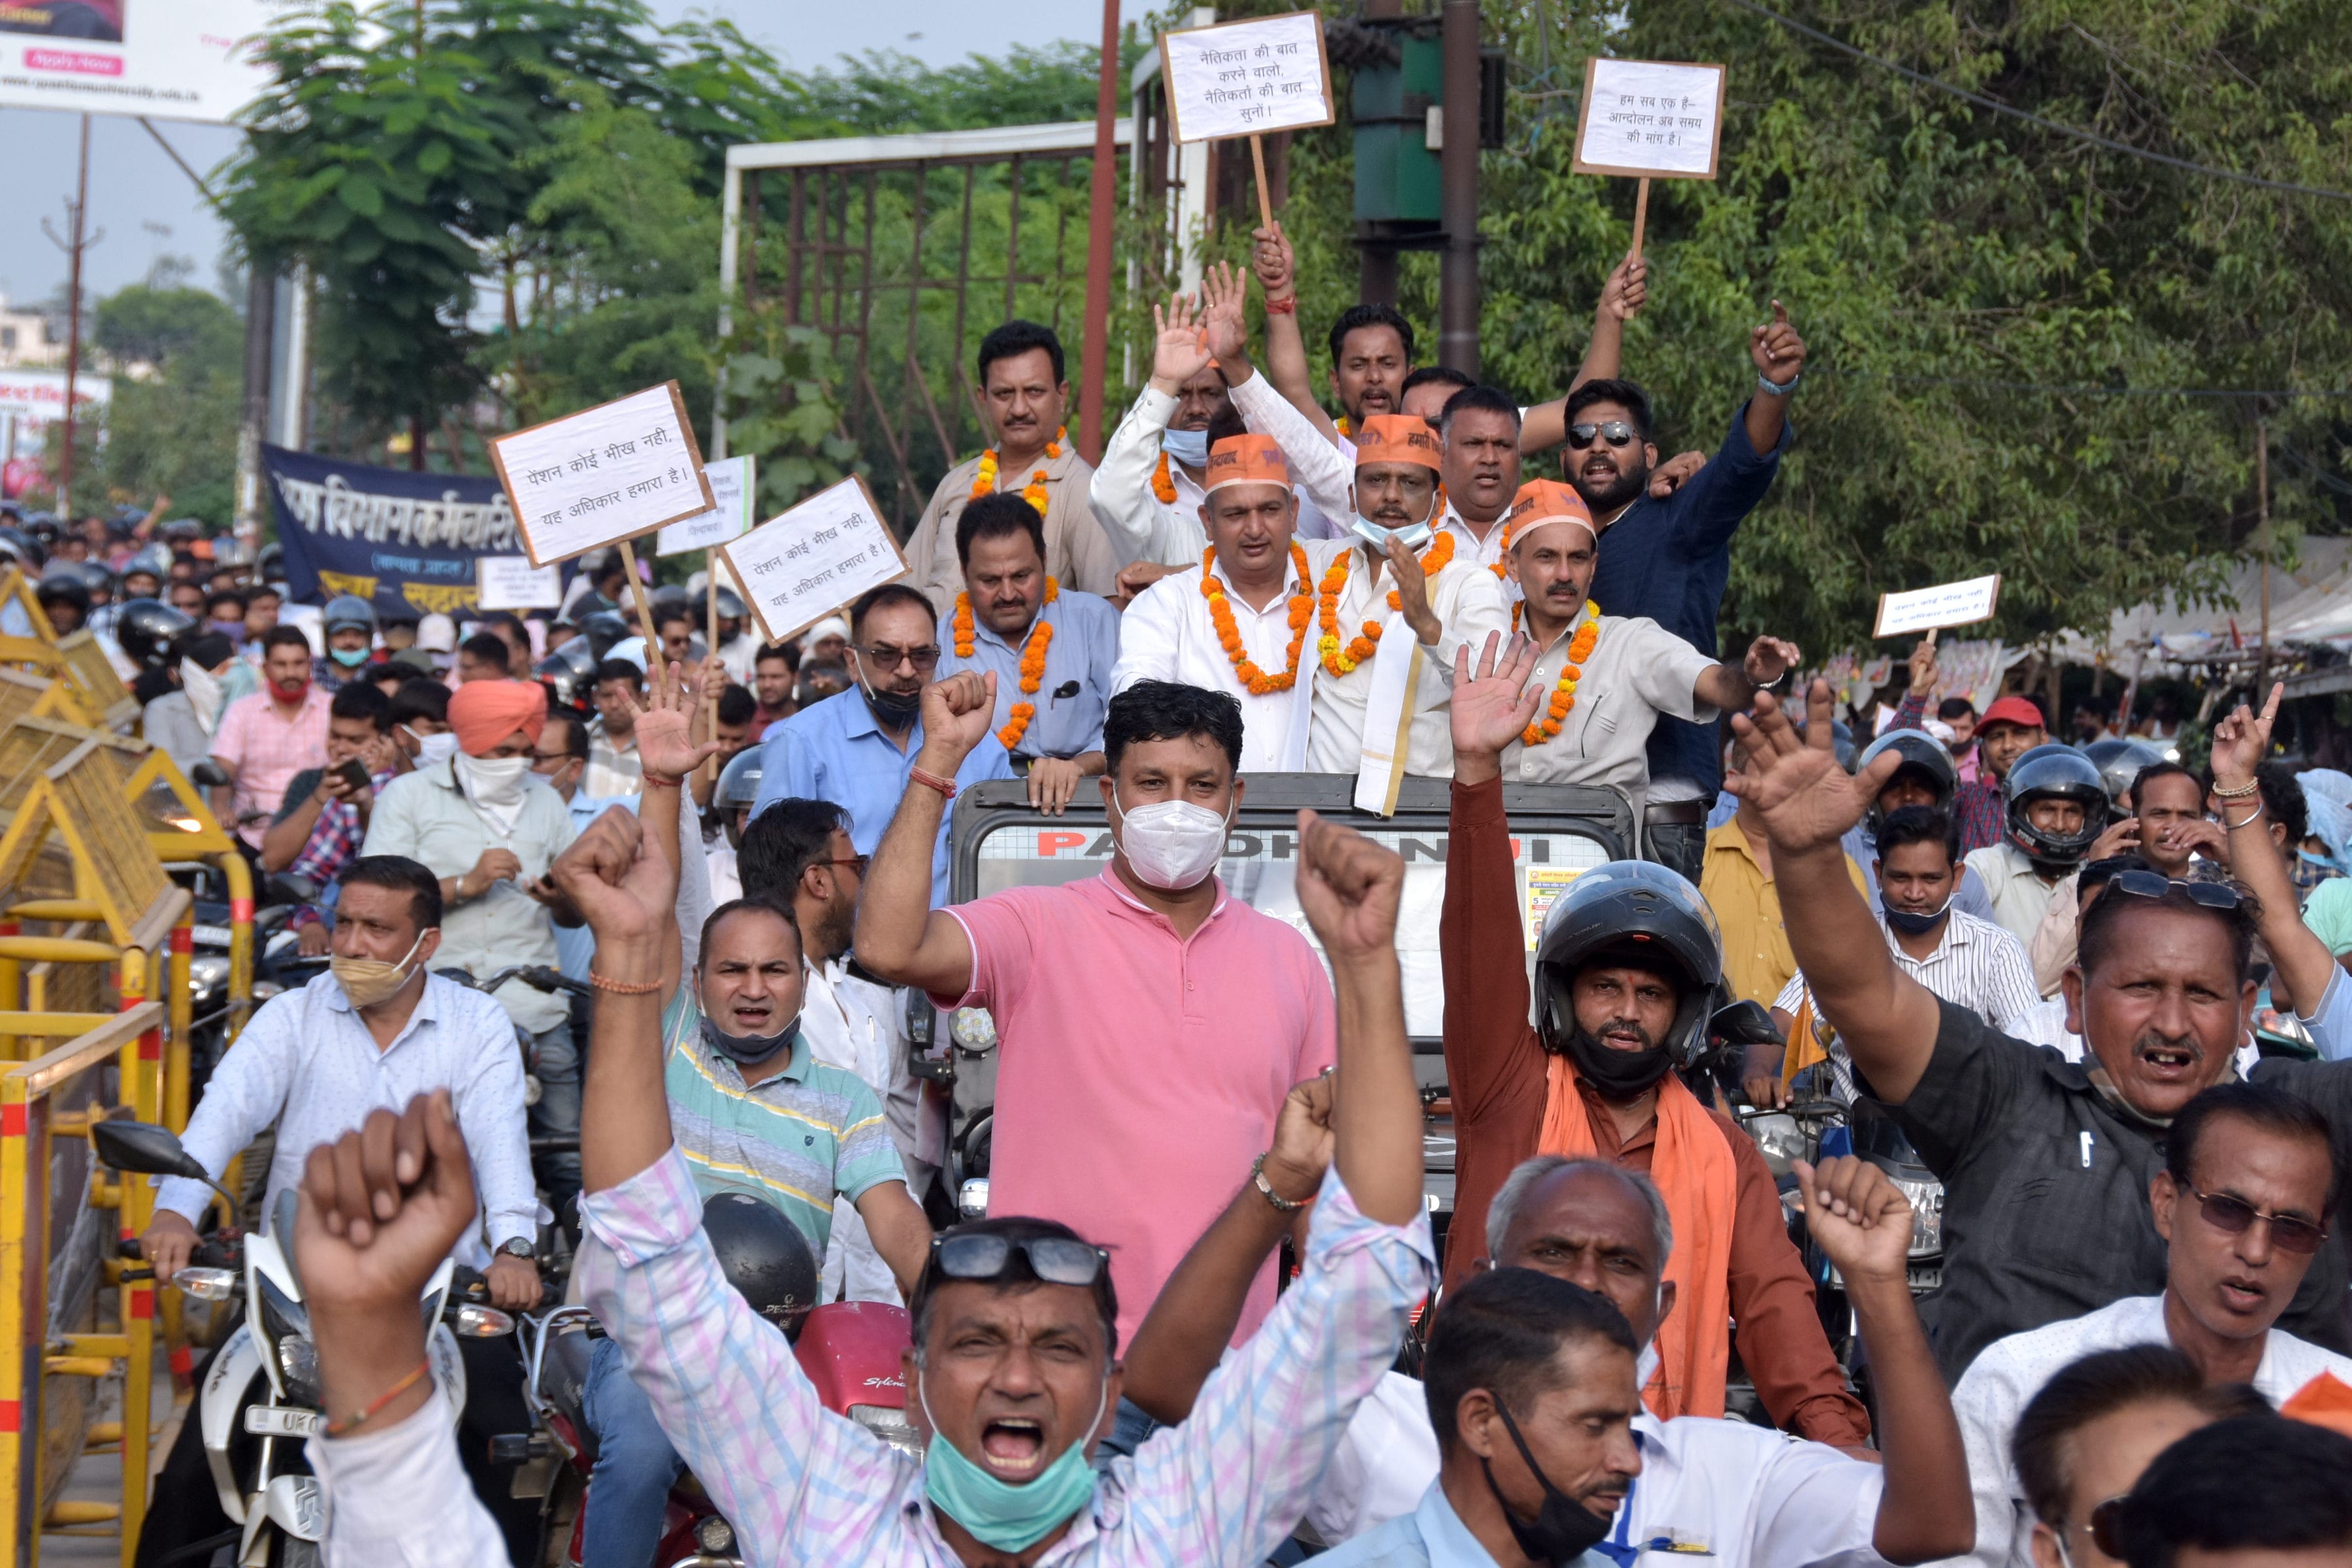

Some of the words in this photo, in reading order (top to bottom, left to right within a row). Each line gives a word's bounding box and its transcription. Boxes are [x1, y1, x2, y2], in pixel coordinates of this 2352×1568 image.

[33, 50, 74, 68] Apply
[76, 57, 114, 71] Now
[1199, 48, 1247, 65] नैतिकता
[1253, 43, 1269, 58] की
[1276, 42, 1298, 55] बात
[1218, 65, 1246, 82] करने
[1258, 82, 1274, 97] की
[1280, 81, 1302, 94] बात
[1620, 94, 1635, 106] हम
[1640, 95, 1656, 107] सब
[1661, 97, 1676, 110] एक
[1609, 110, 1654, 125] आन्दोलन
[1658, 116, 1673, 127] अब
[1679, 117, 1702, 129] समय
[1627, 129, 1641, 143] की
[1646, 131, 1664, 144] मांग
[527, 465, 563, 485] पेंशन
[567, 449, 599, 472] कोई
[604, 440, 636, 460] भीख
[541, 510, 562, 525] यह
[568, 491, 621, 517] अधिकार
[626, 476, 663, 498] हमारा
[753, 556, 783, 576] पेंशन
[785, 538, 810, 559] कोई
[812, 526, 838, 545] भीख
[770, 592, 789, 607] यह
[792, 568, 834, 596] अधिकार
[836, 552, 866, 574] हमारा
